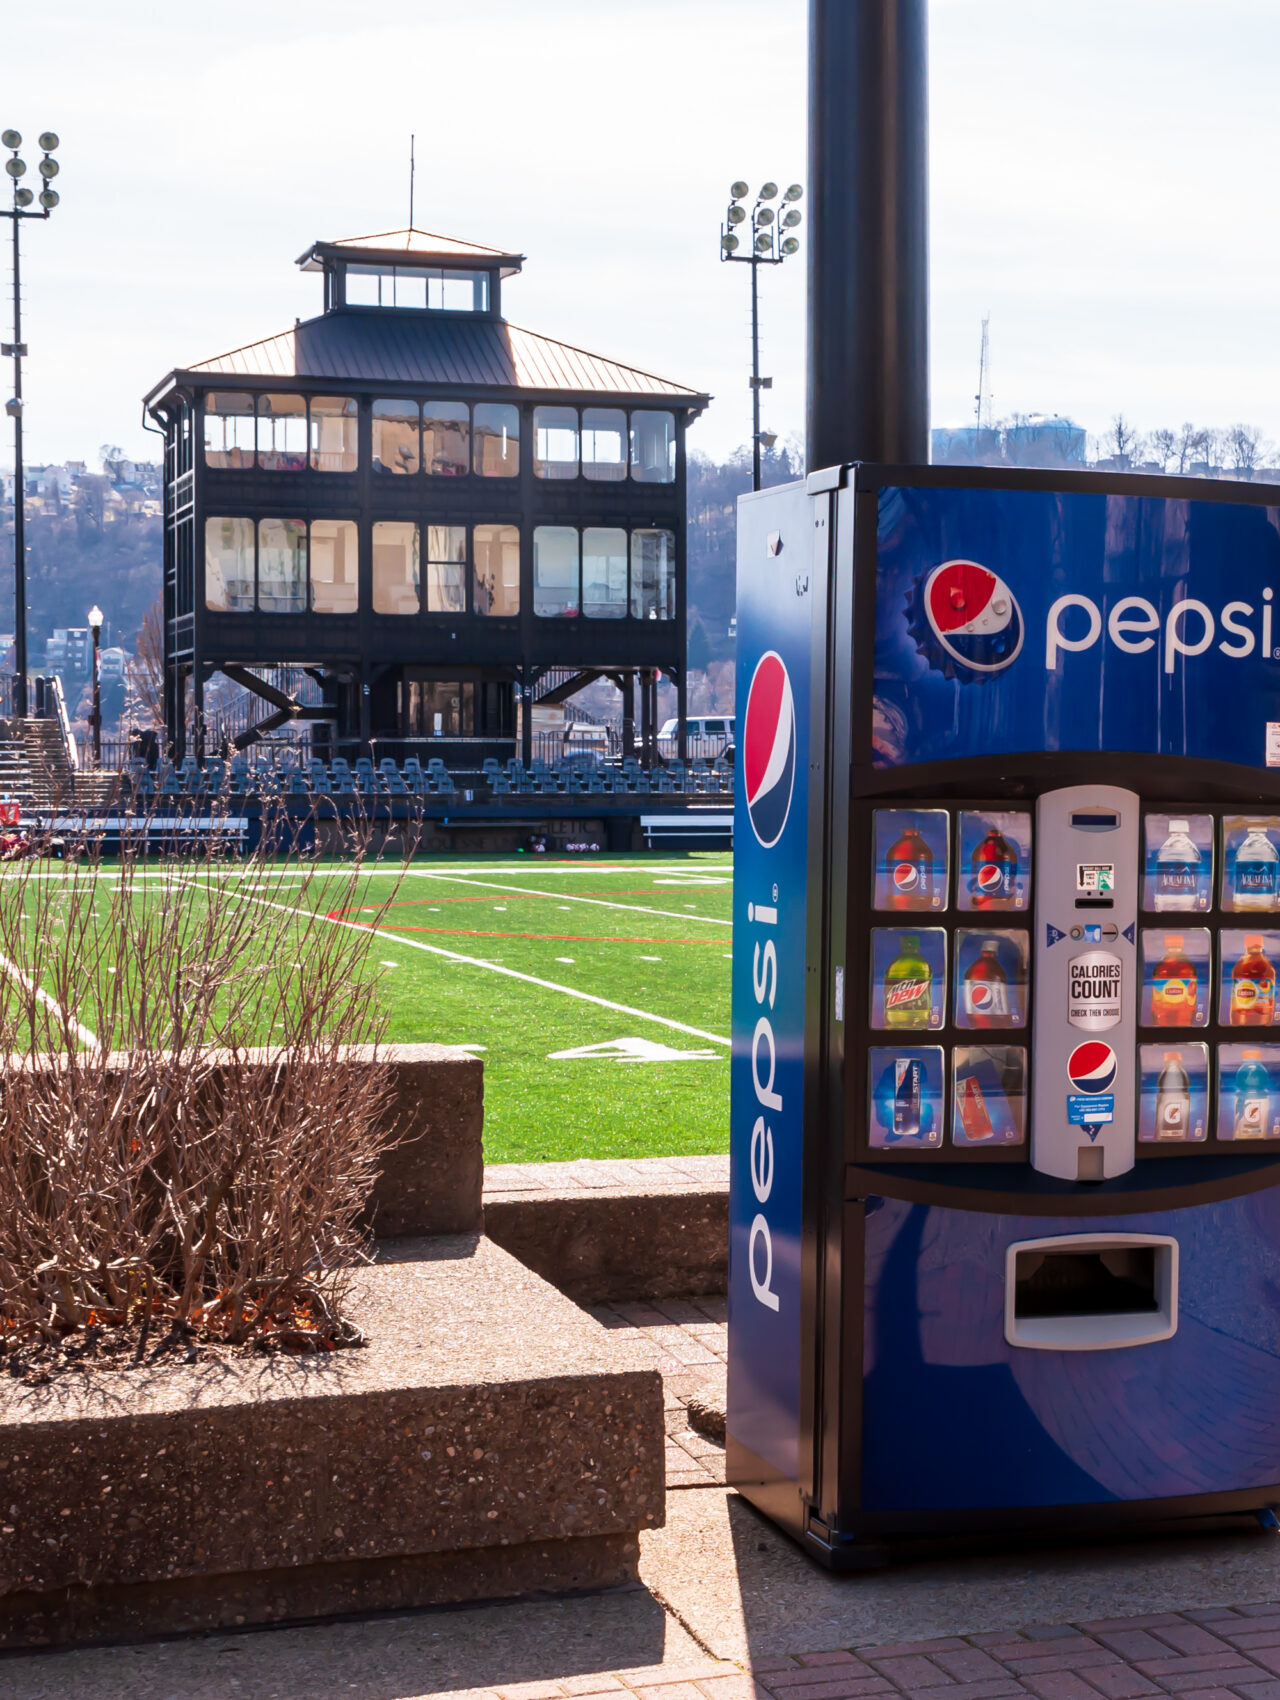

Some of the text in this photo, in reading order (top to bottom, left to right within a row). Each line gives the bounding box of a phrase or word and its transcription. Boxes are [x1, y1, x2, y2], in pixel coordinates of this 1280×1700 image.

[1046, 587, 1274, 674] pepsi
[1071, 965, 1121, 978] CALORIES
[1071, 980, 1121, 999] COUNT
[1071, 1008, 1120, 1017] CHECK THEN CHOOSE
[747, 901, 783, 1312] pepsi
